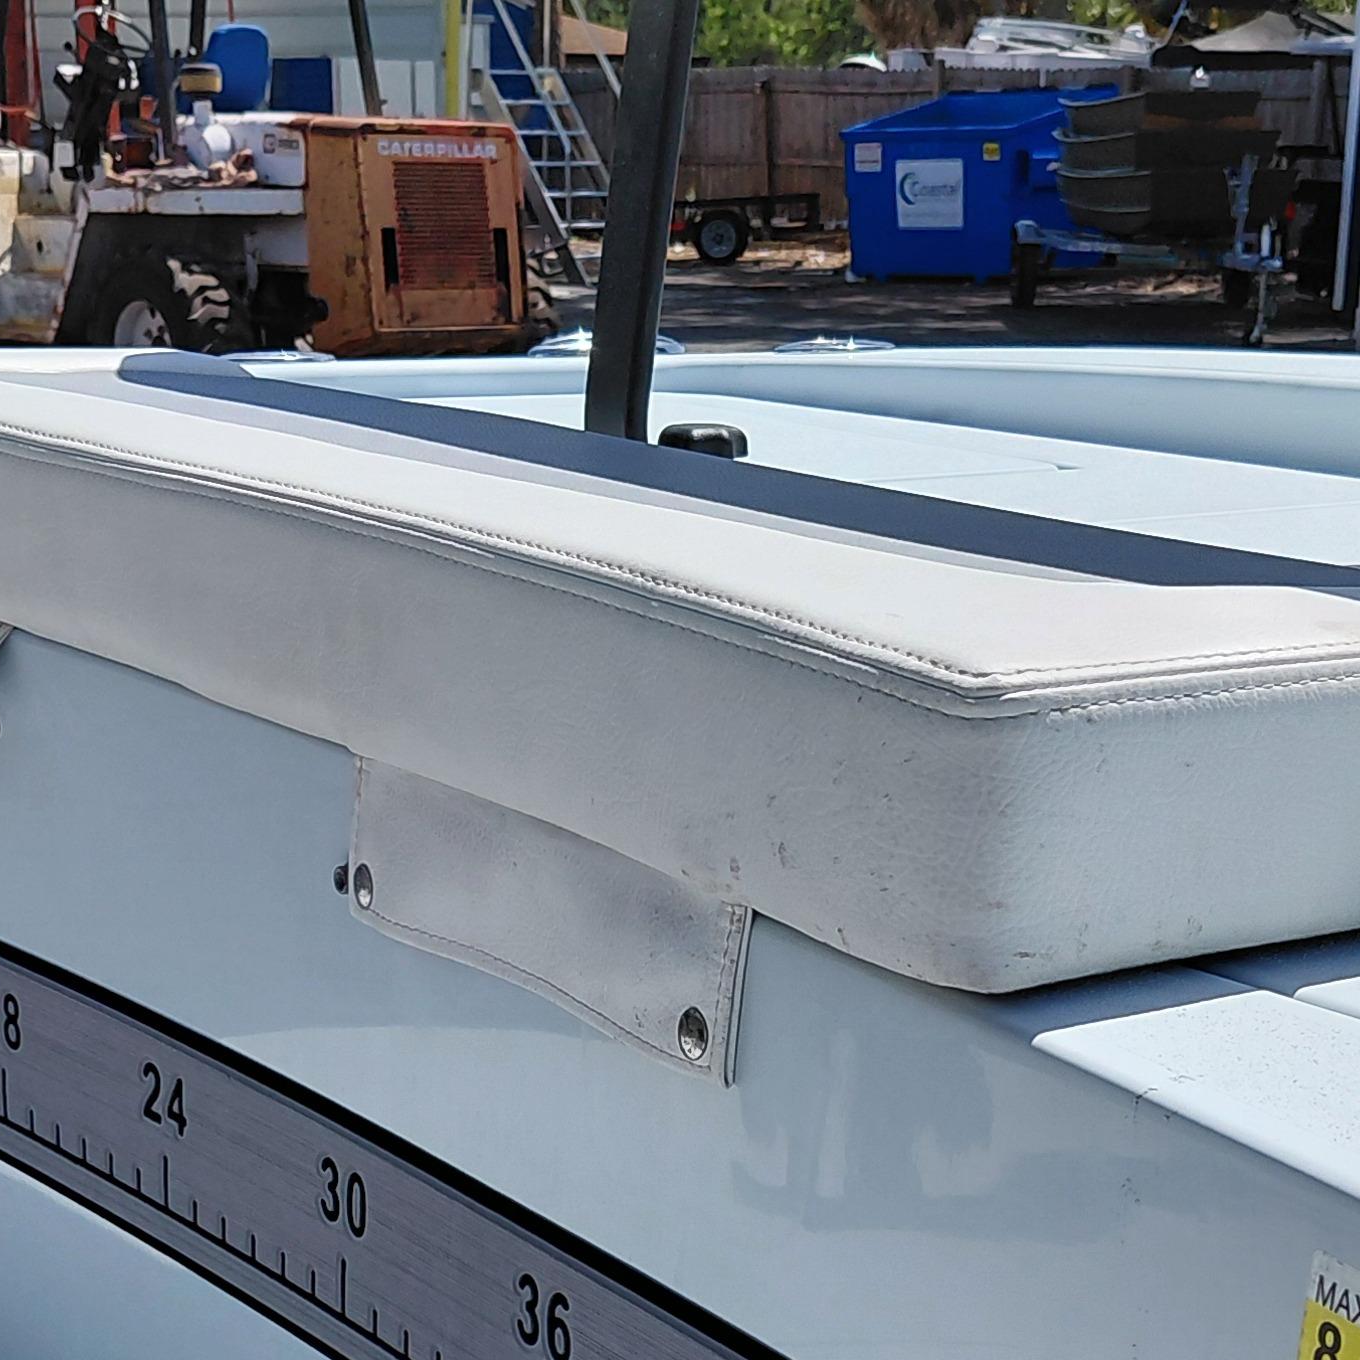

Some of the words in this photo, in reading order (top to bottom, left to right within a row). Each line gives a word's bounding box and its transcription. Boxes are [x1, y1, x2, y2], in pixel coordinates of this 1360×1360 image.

[377, 140, 498, 159] CATERPILLAR
[142, 1062, 189, 1136] 24
[320, 1156, 368, 1238] 30
